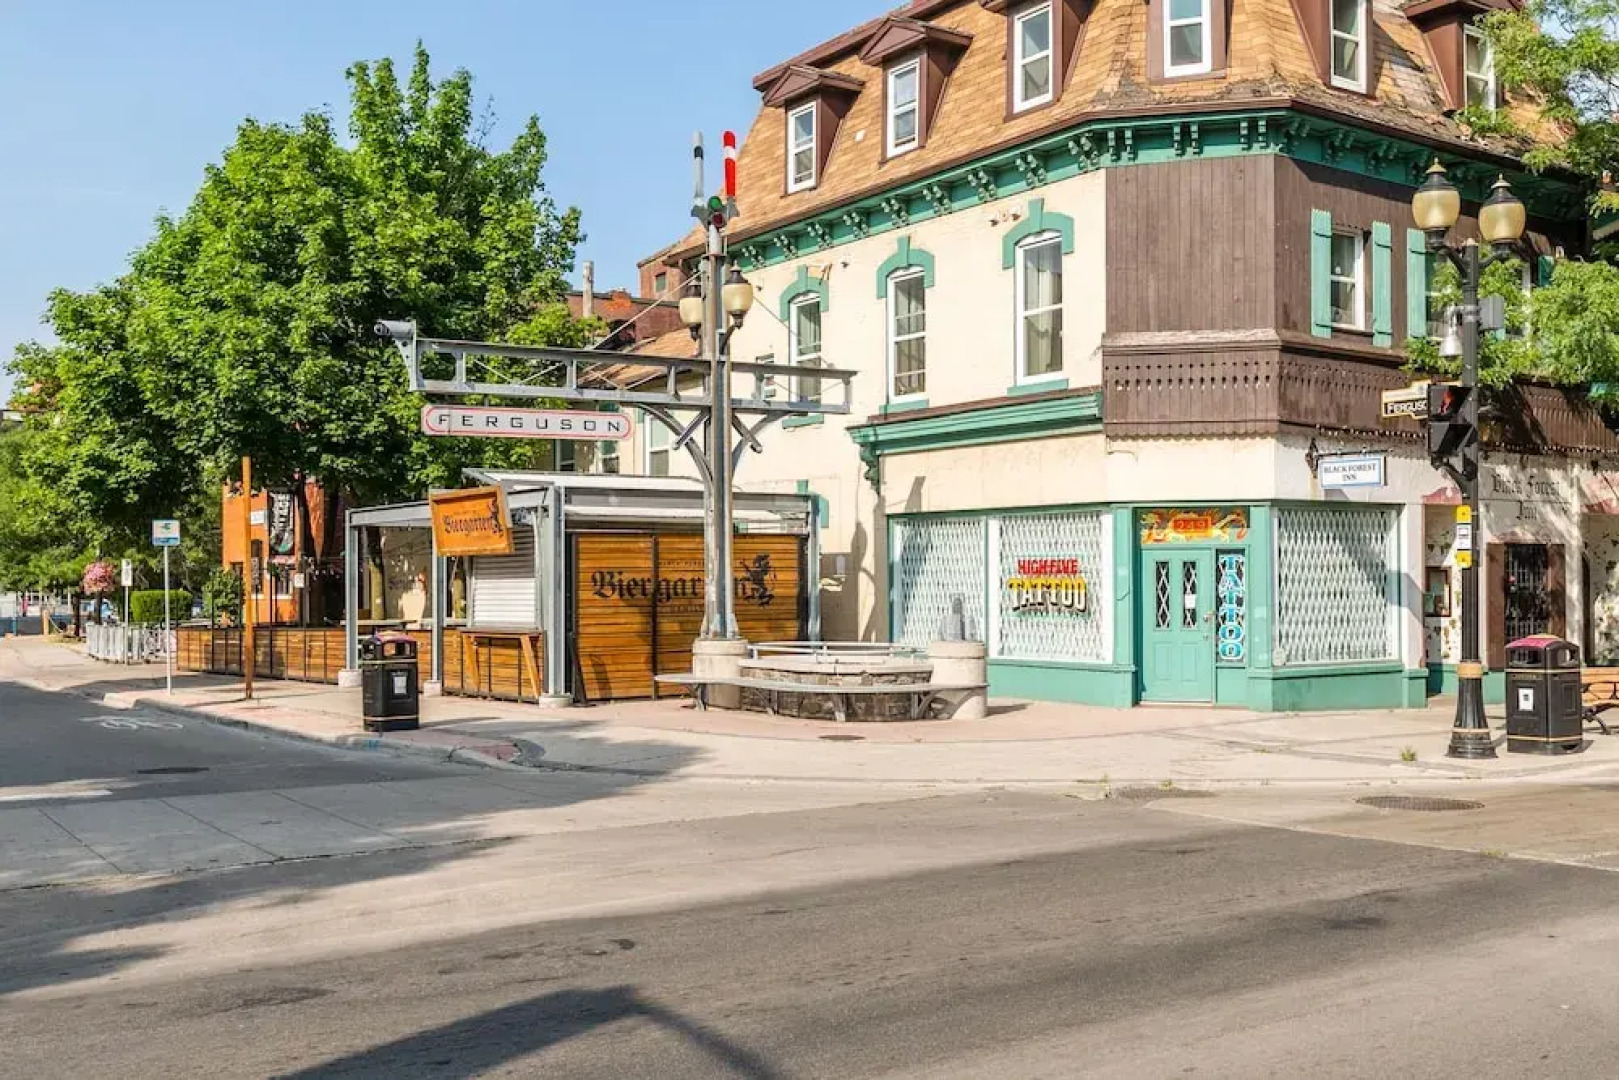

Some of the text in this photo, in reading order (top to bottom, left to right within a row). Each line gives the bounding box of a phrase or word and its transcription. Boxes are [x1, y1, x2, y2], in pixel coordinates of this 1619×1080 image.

[438, 414, 620, 432] FERGUSON
[1342, 473, 1357, 481] INN
[1348, 463, 1376, 472] FOREST
[442, 513, 493, 535] Biergarten
[591, 570, 758, 604] Biergarn
[1007, 578, 1087, 612] TATTOO
[1219, 556, 1243, 659] TATTOO
